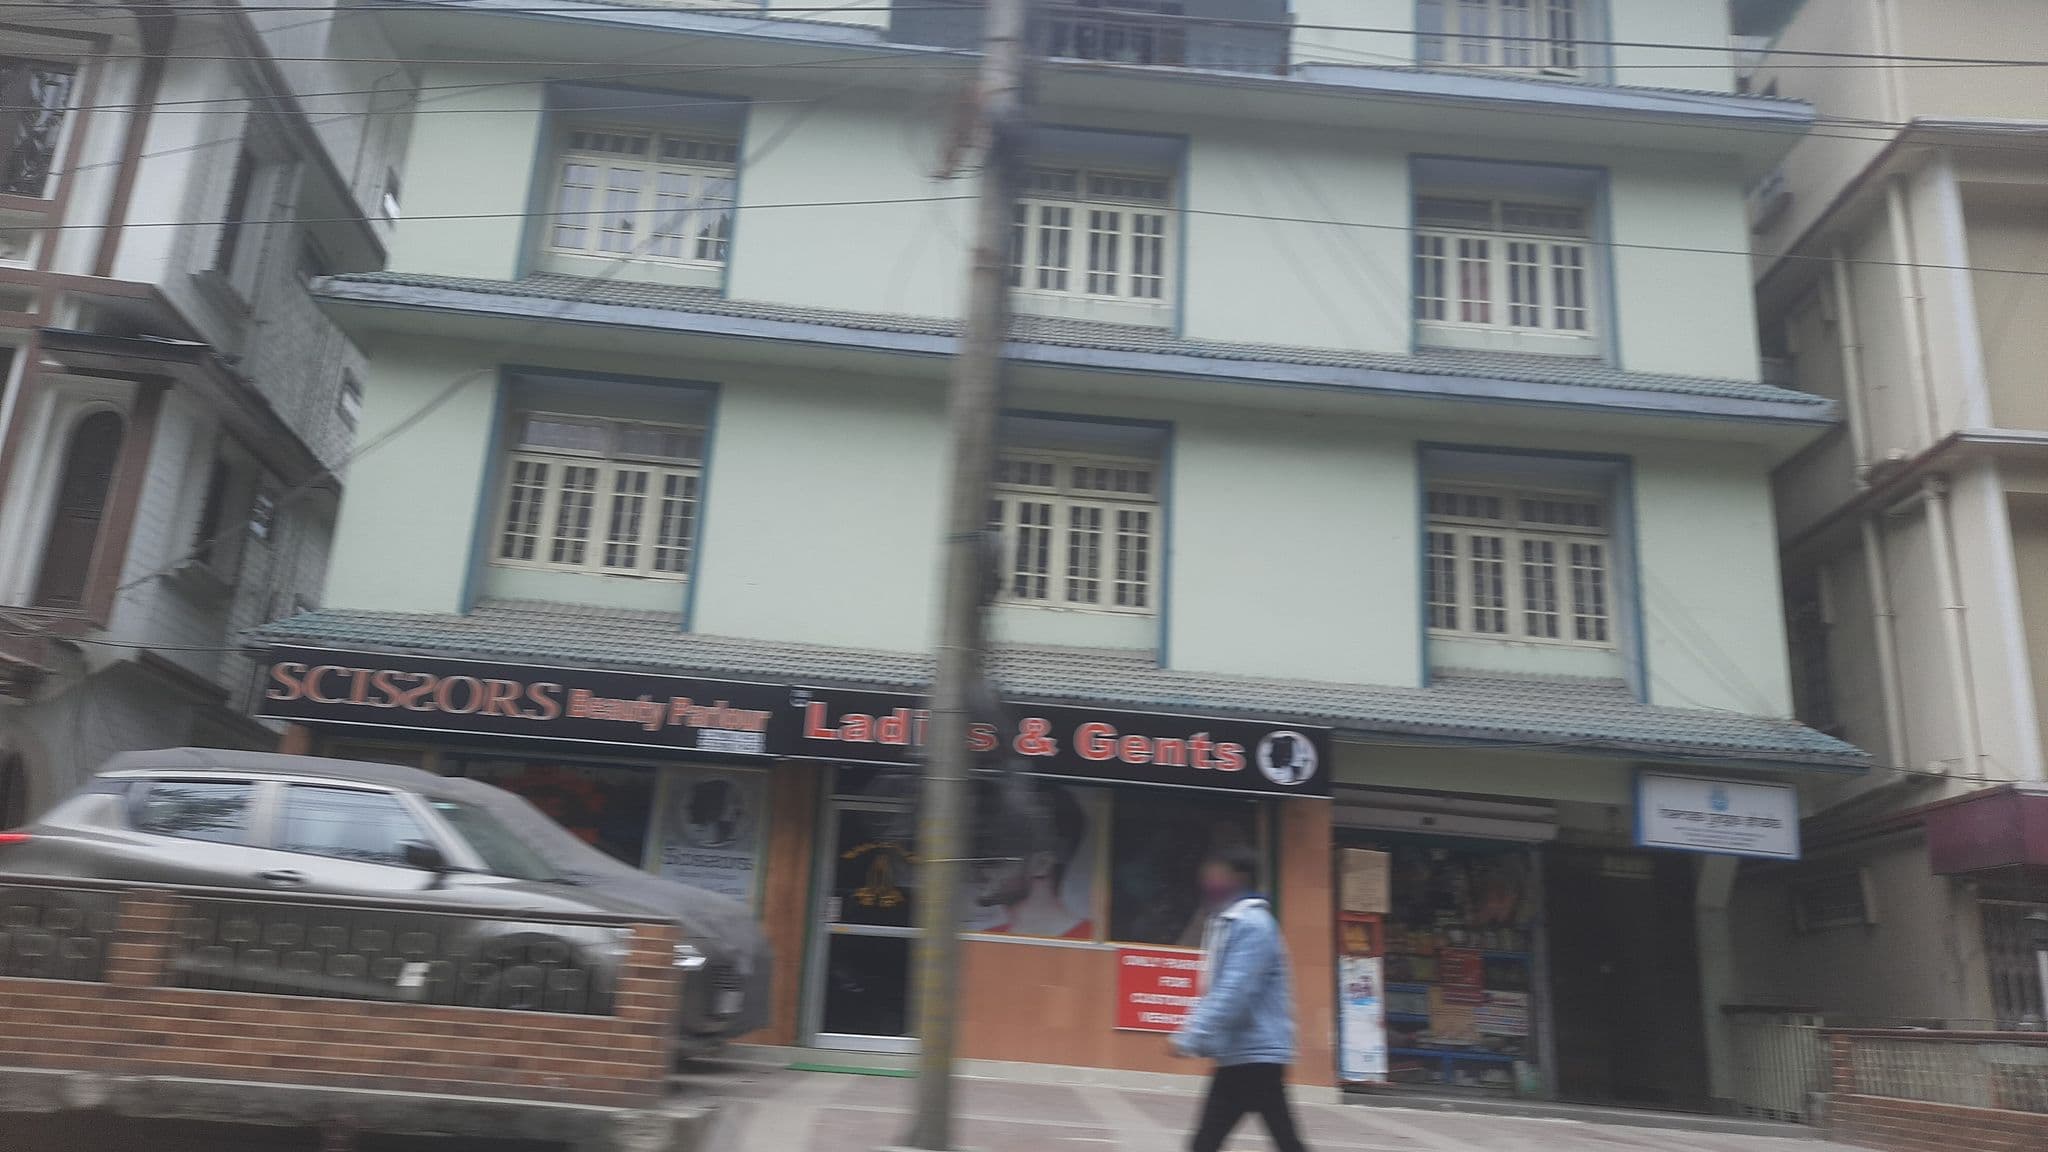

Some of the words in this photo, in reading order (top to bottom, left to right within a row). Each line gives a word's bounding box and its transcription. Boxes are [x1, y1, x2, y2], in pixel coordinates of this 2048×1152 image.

[266, 661, 562, 721] SCISSORS
[566, 688, 668, 731] Beauty
[667, 696, 772, 732] Parlour
[803, 701, 999, 752] Ladis
[1013, 716, 1058, 757] &
[1073, 722, 1247, 772] Gents
